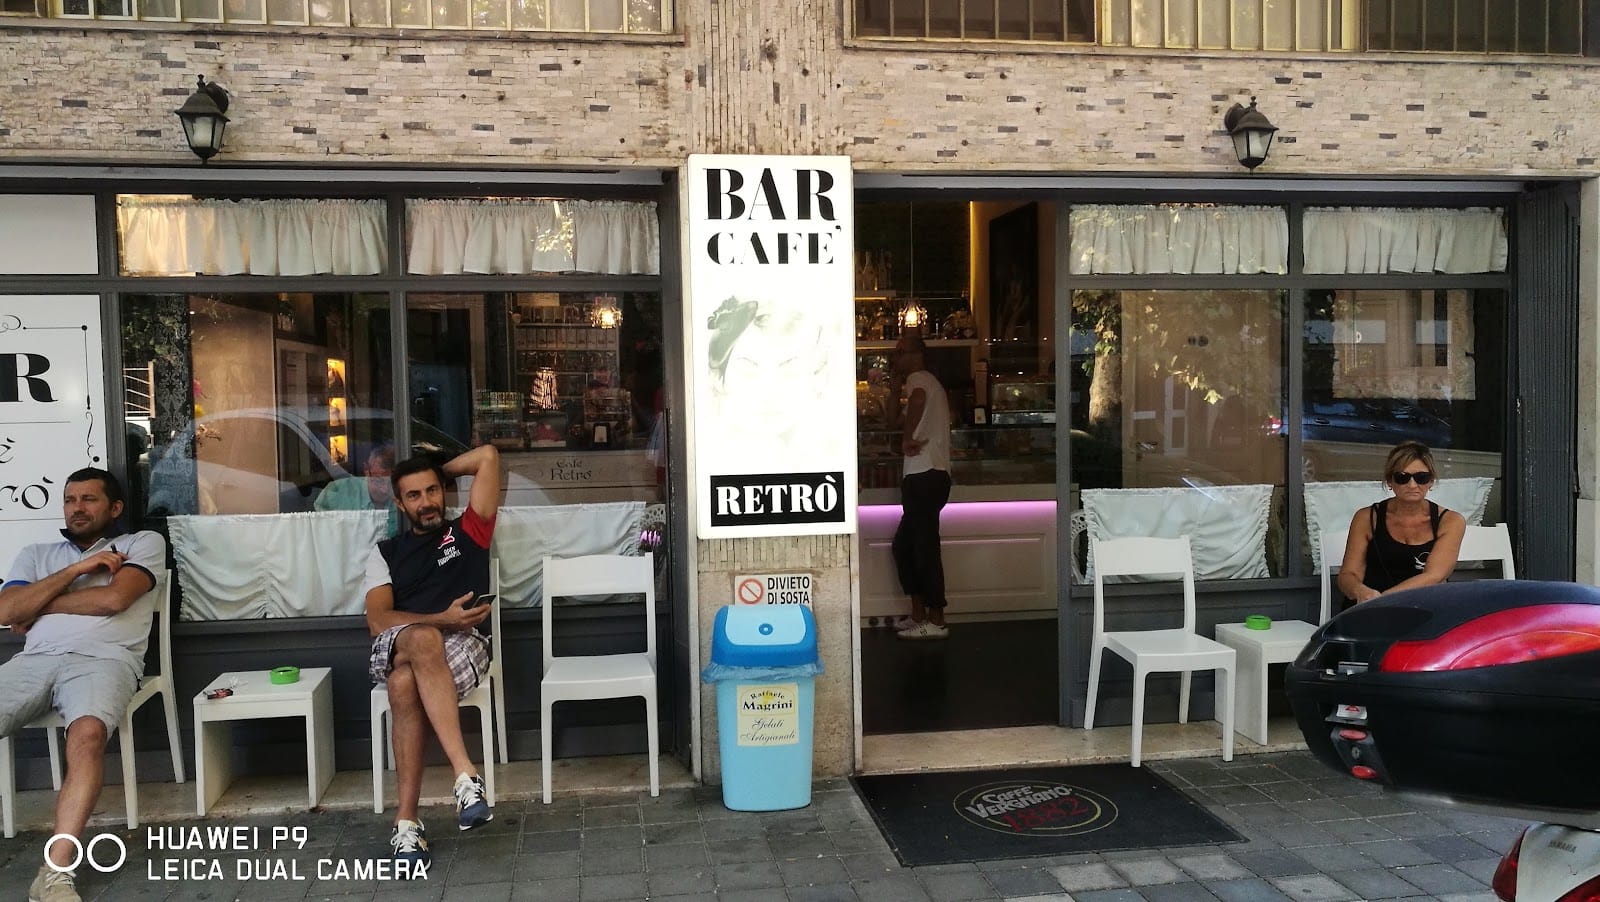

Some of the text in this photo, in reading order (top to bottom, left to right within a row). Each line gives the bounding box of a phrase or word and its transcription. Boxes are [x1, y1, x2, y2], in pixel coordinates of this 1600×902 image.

[704, 167, 839, 222] BAR
[715, 474, 838, 516] RETRÒ
[767, 576, 810, 590] DIVIETO
[767, 591, 810, 605] DI SOSTA
[750, 690, 785, 699] Raffaele
[743, 700, 793, 711] Magrini
[752, 718, 785, 730] Gelati
[741, 729, 795, 743] Artigianali
[1003, 796, 1089, 832] 1882
